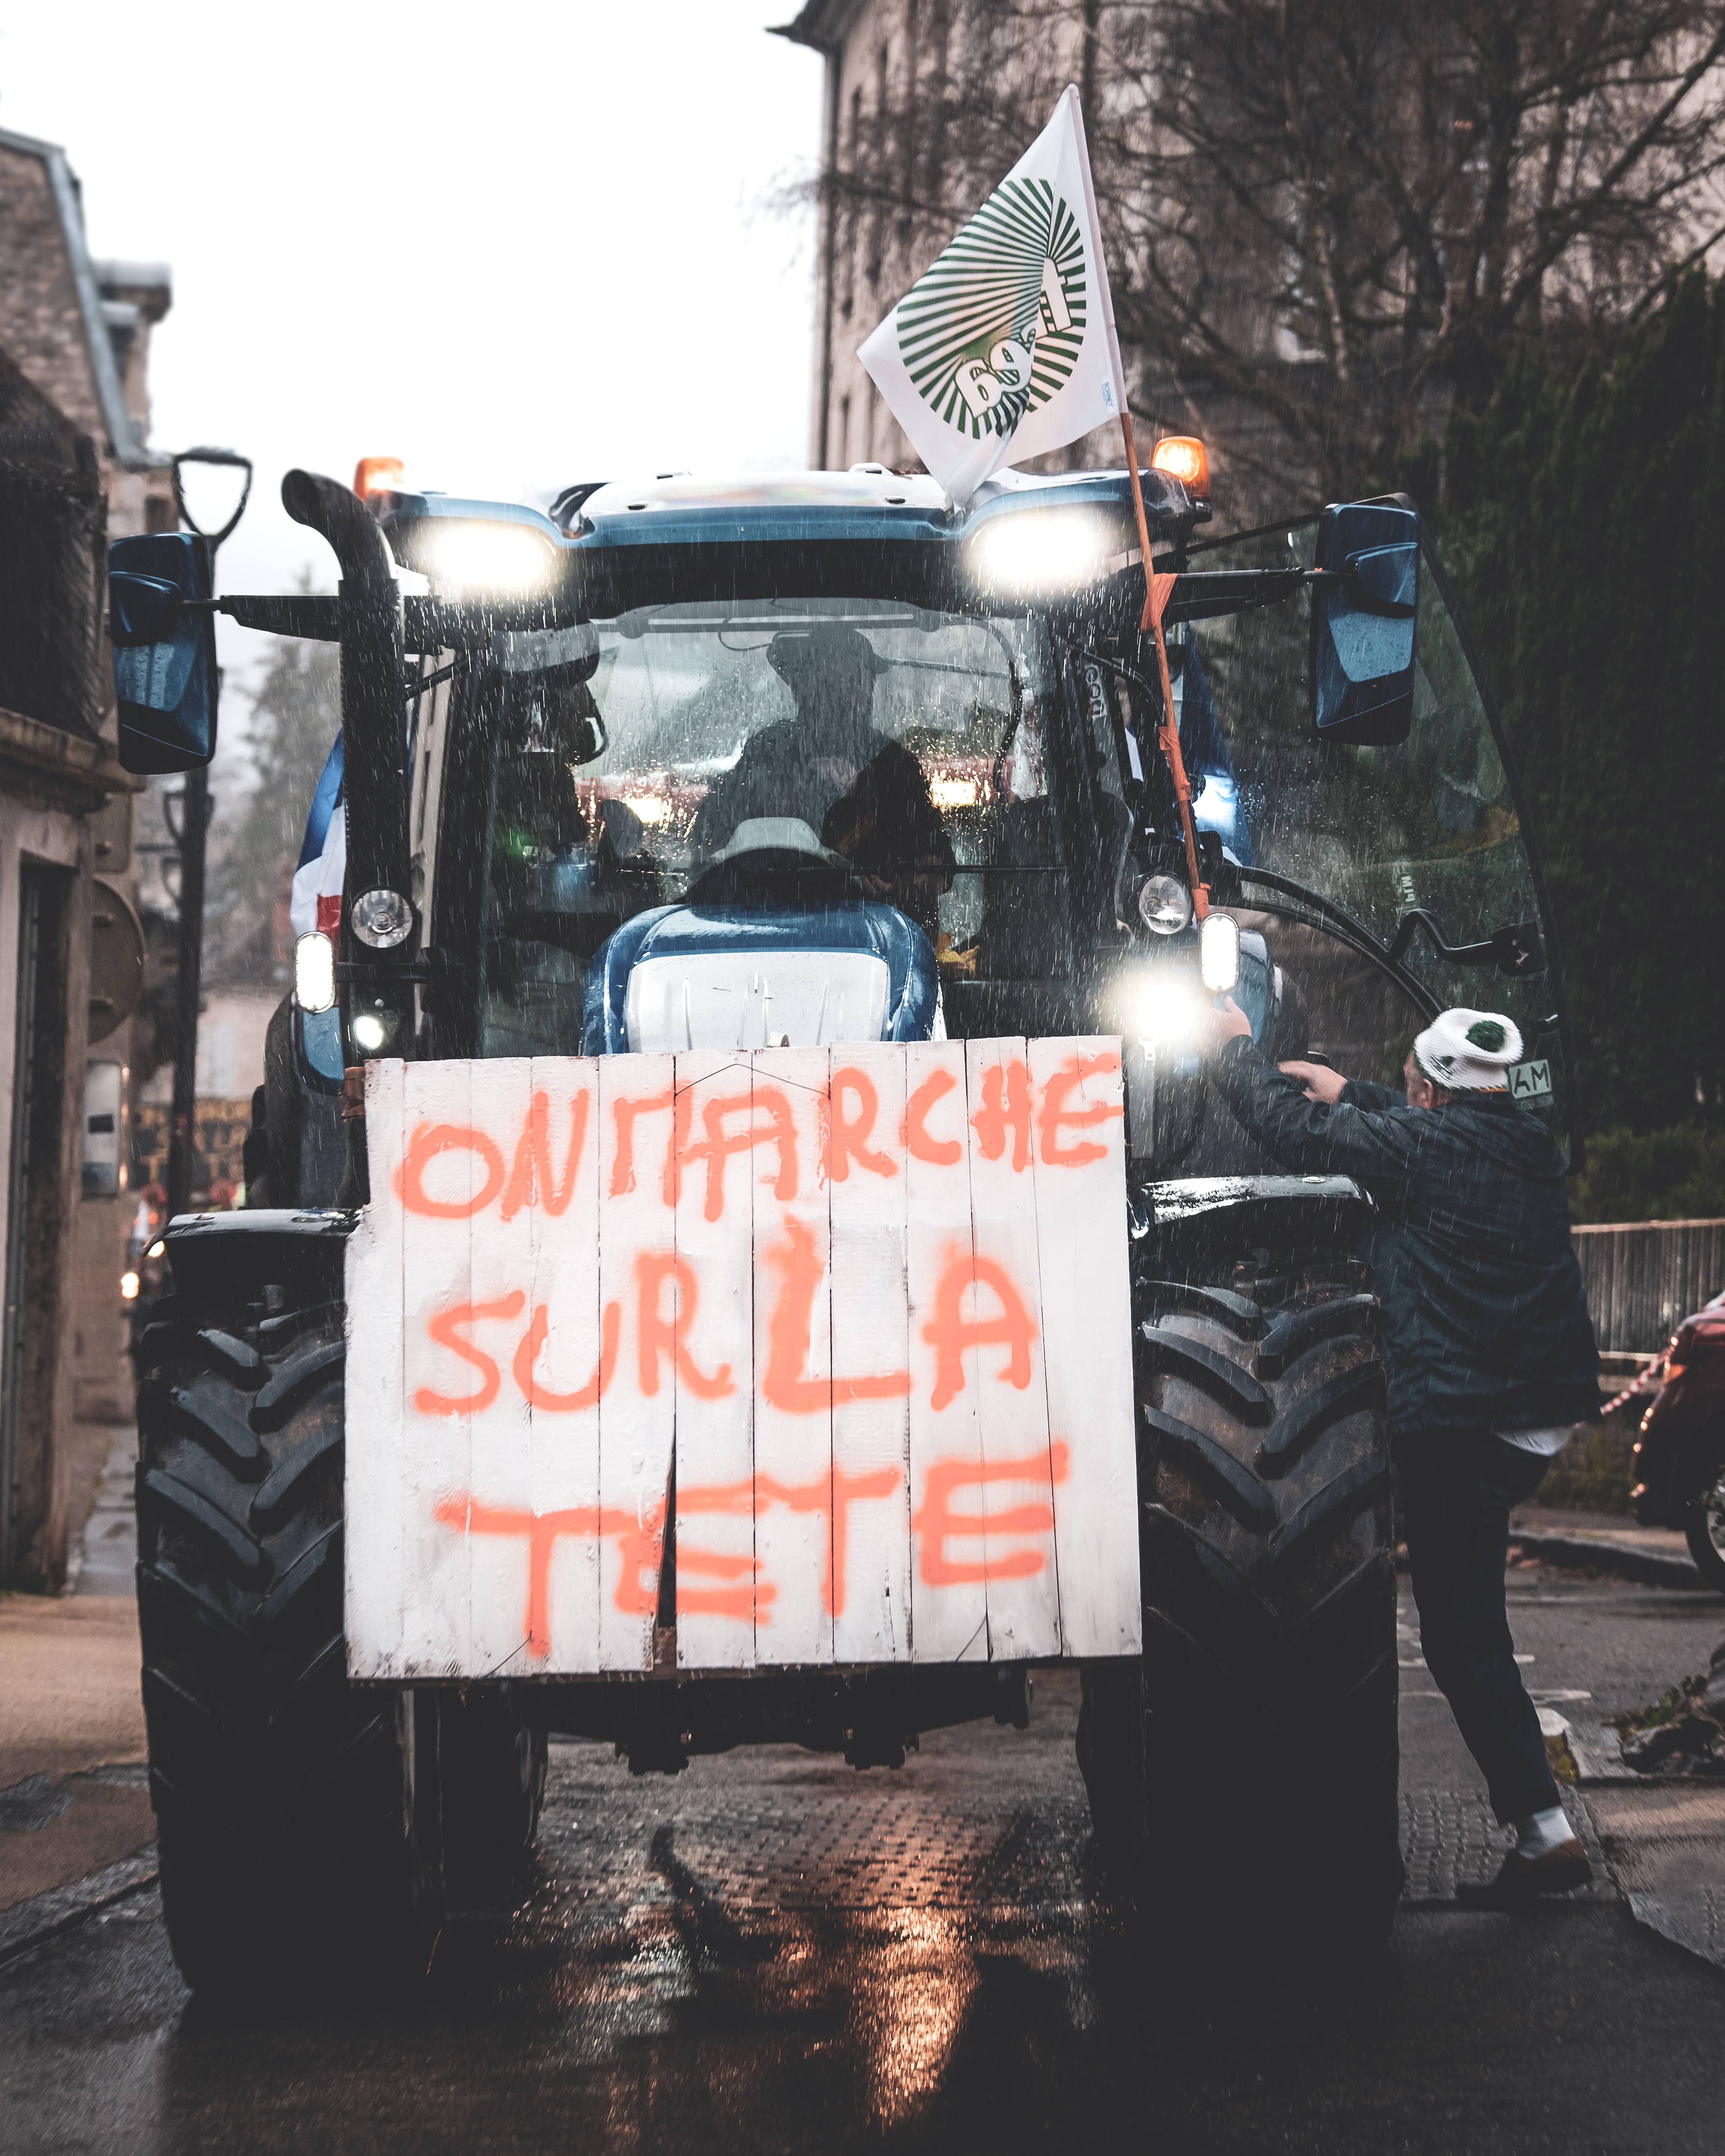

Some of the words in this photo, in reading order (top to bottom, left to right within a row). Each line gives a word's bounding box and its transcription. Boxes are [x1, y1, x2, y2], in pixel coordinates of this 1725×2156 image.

[391, 1087, 591, 1223] ON
[412, 1248, 736, 1418] SUR
[762, 1213, 1040, 1416] LA
[433, 1439, 1070, 1660] TETE
